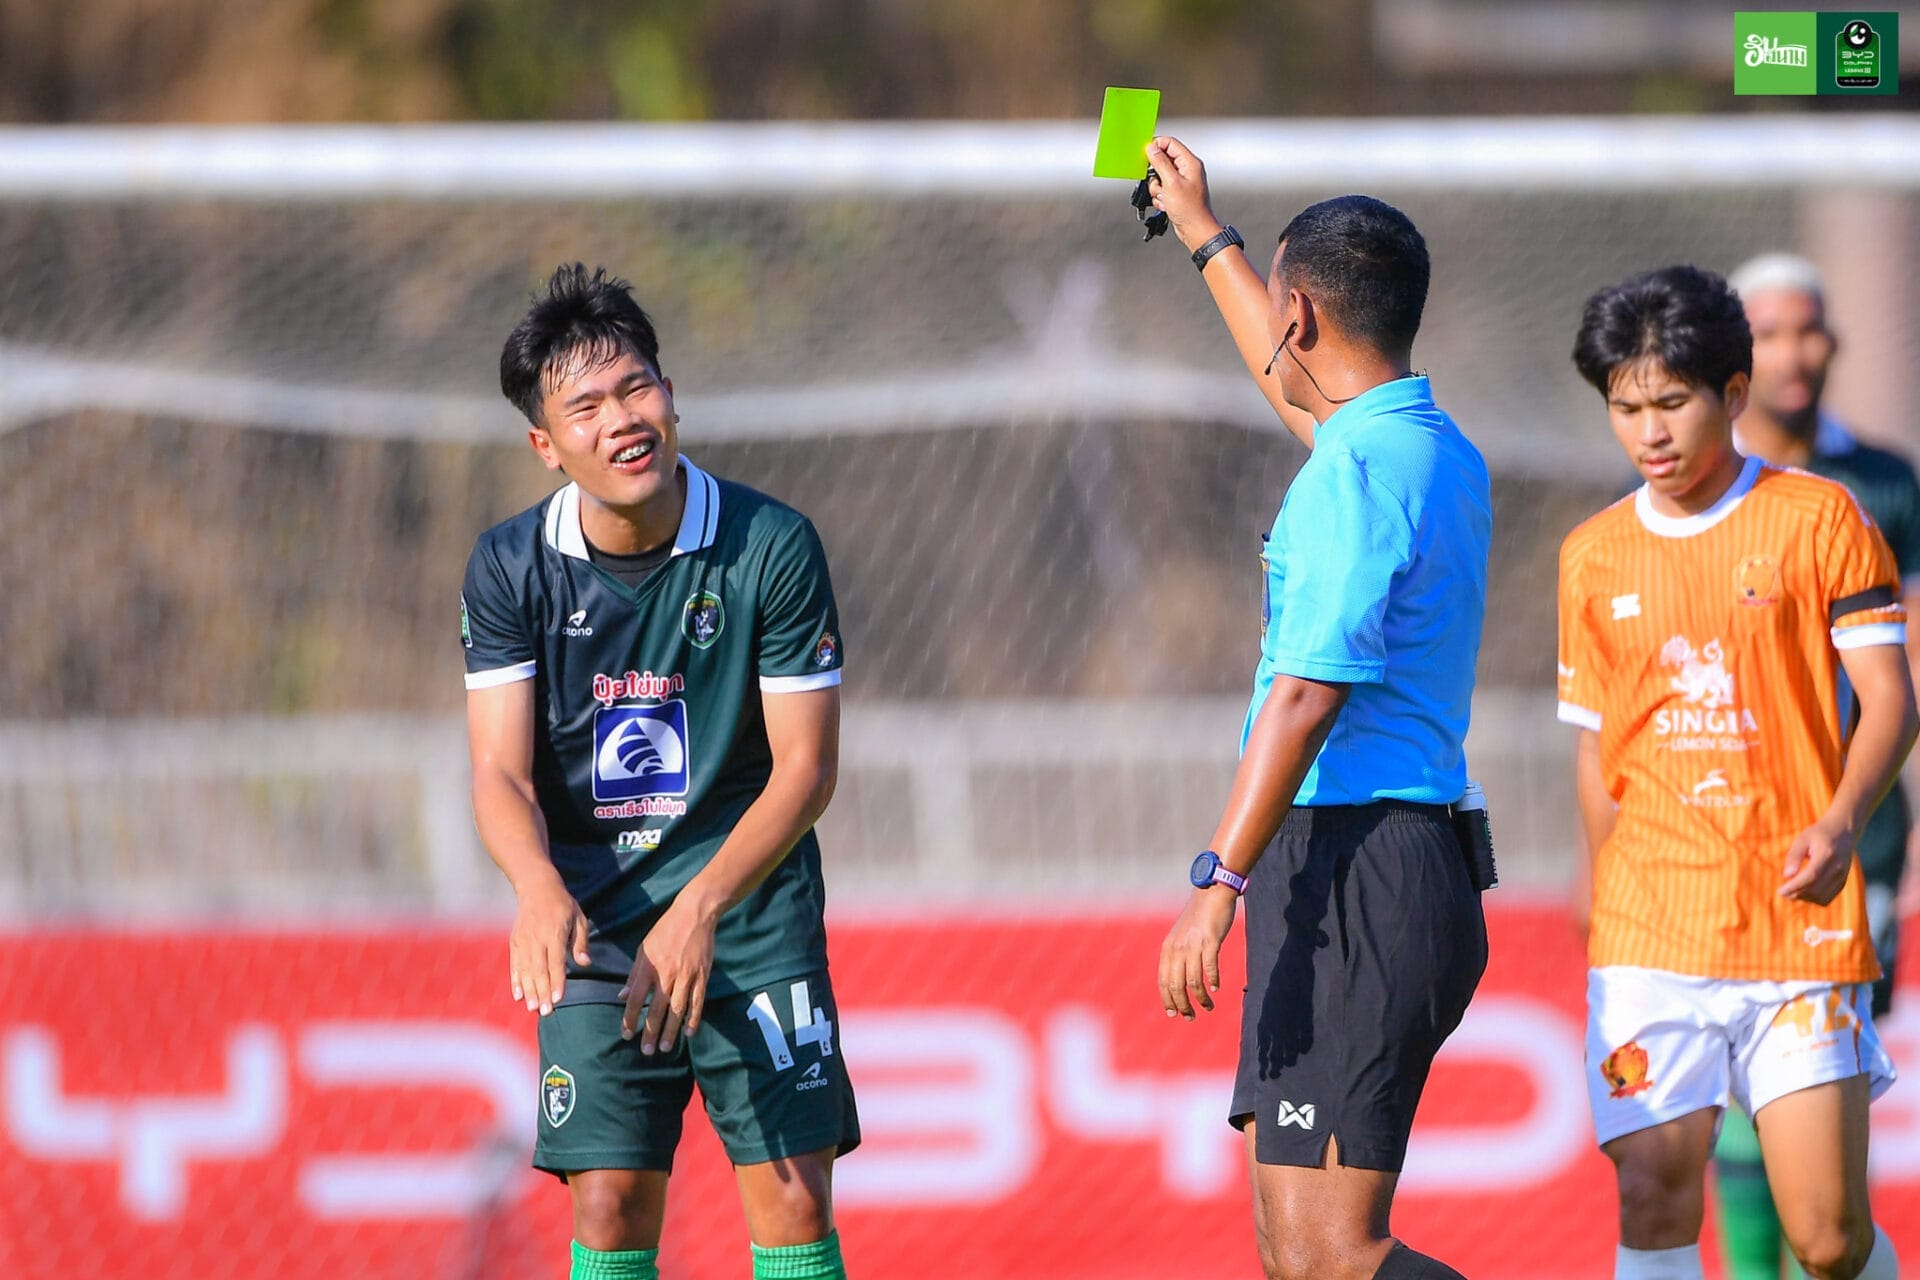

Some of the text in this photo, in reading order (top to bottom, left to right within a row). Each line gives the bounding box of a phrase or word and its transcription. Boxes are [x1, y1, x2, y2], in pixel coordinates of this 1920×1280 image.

[593, 670, 685, 706] ปุ๋ยไข่มุก
[746, 981, 833, 1072] 14
[796, 1078, 828, 1091] acono
